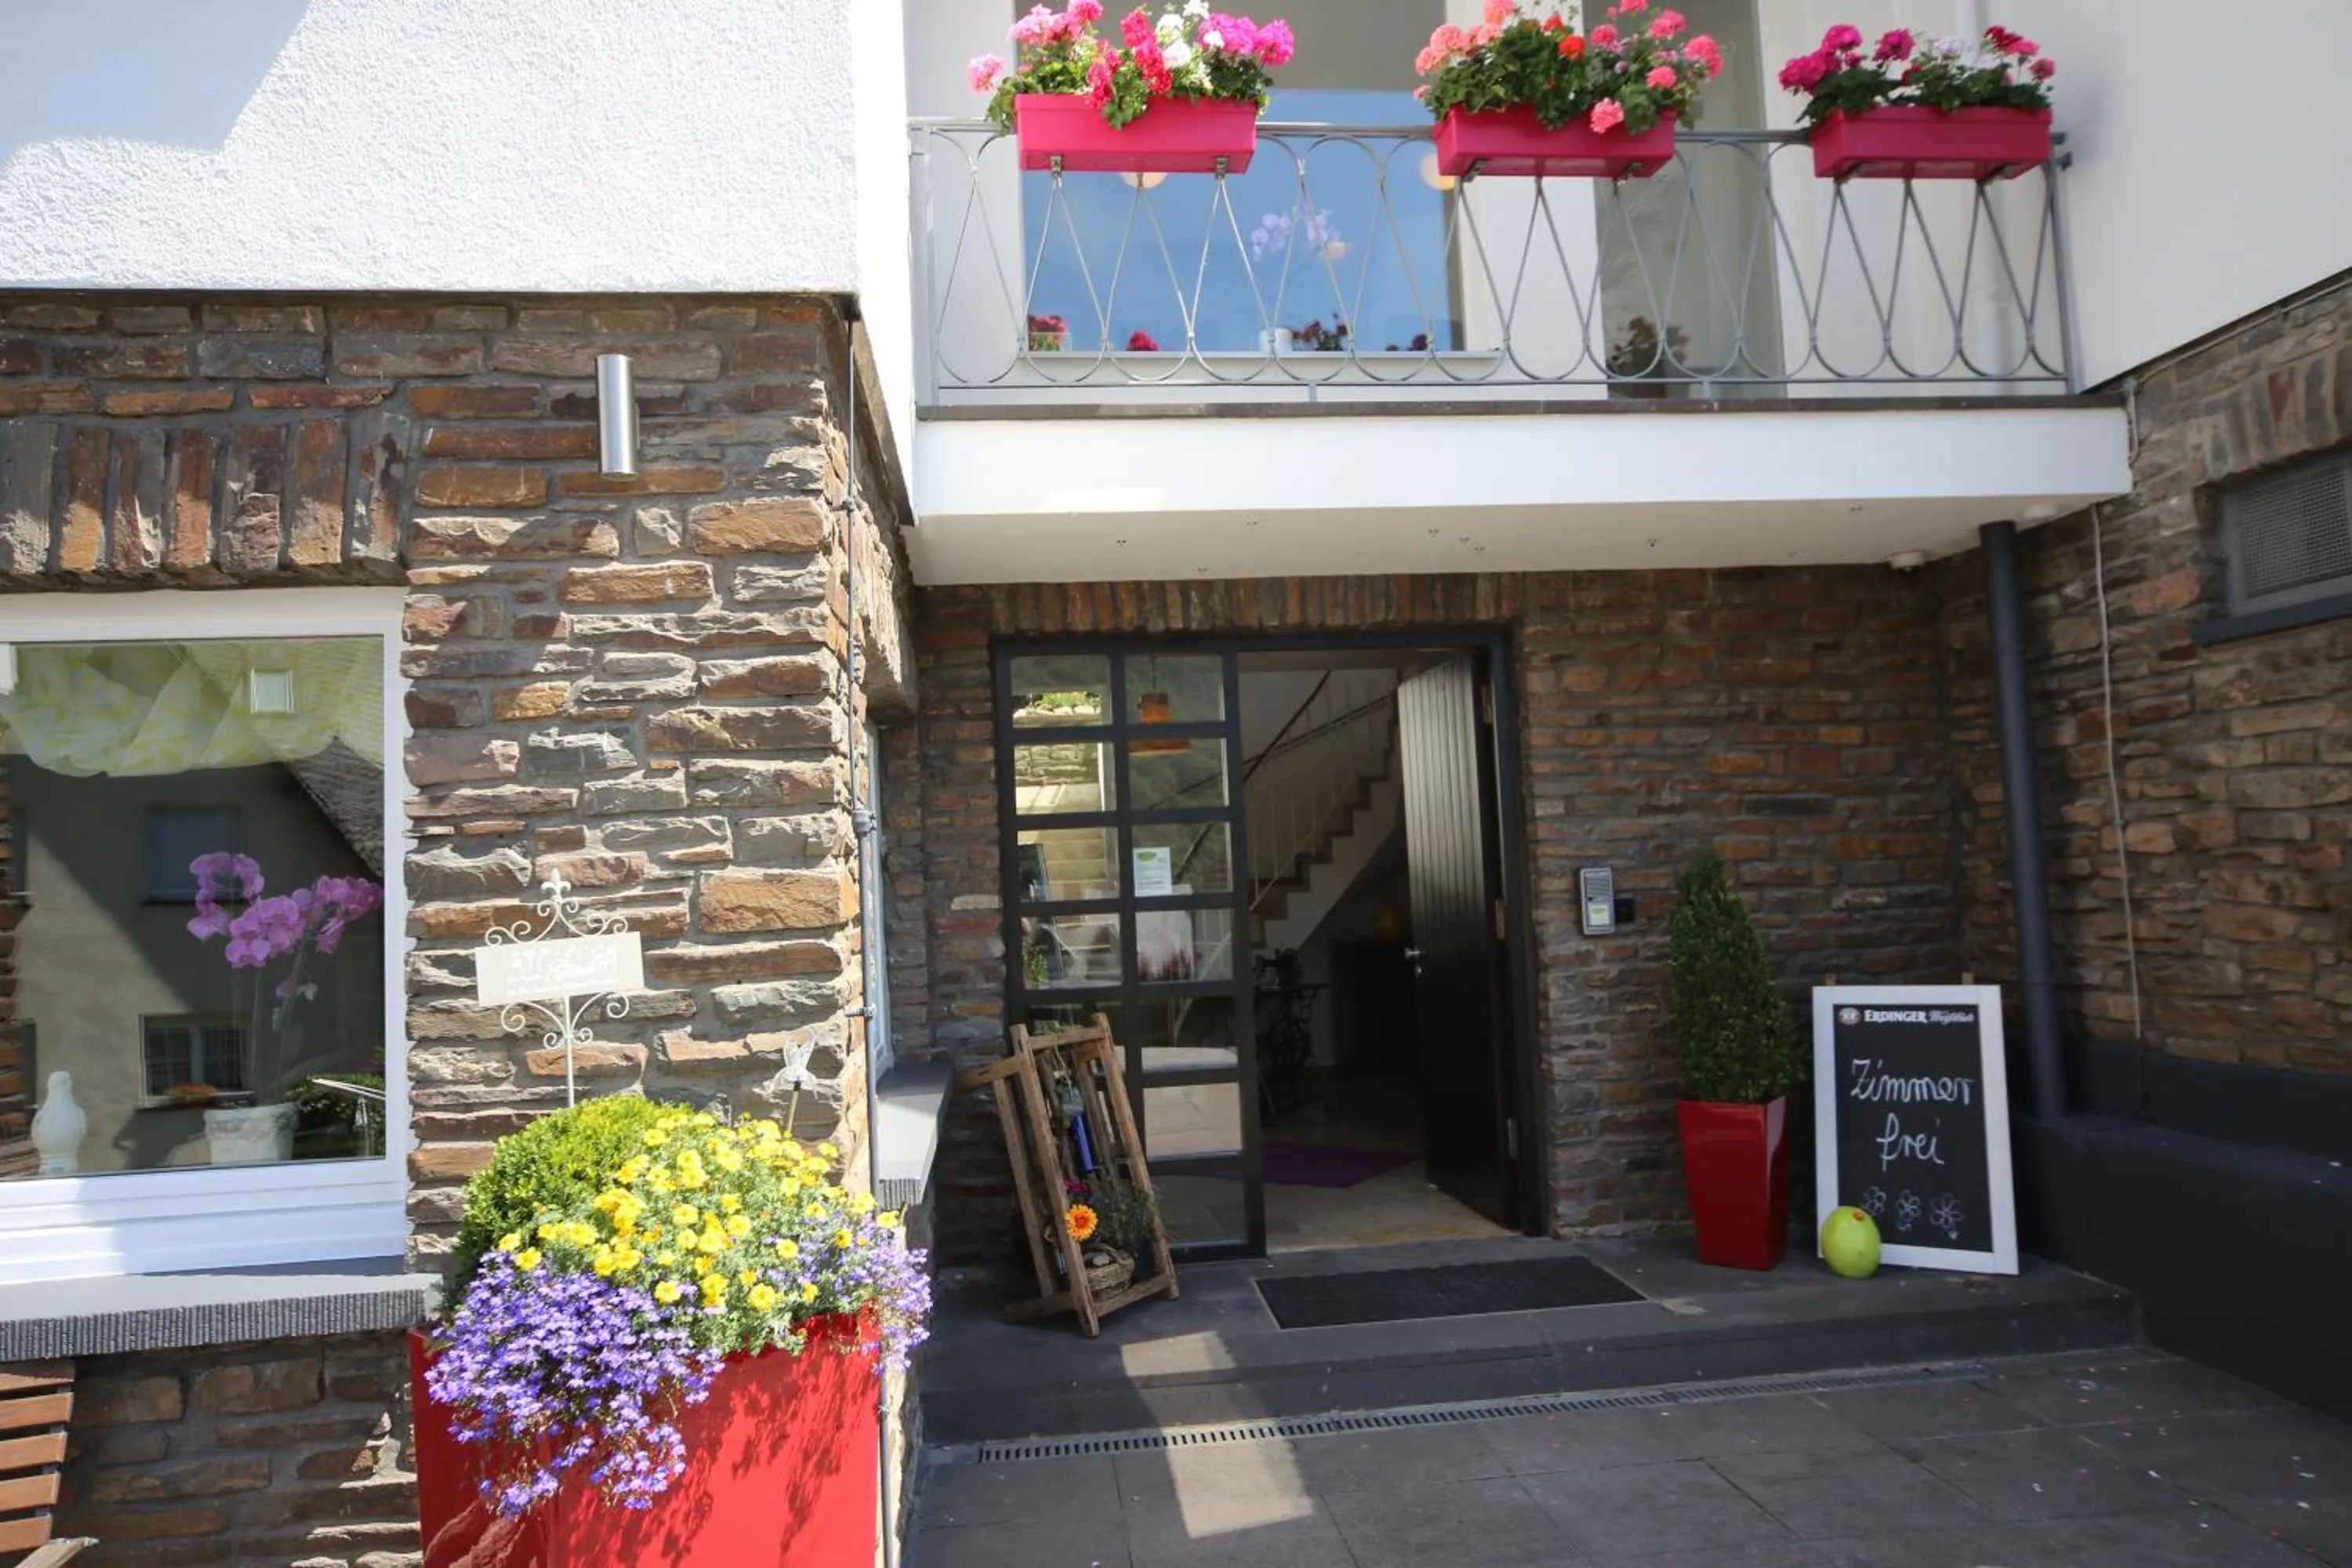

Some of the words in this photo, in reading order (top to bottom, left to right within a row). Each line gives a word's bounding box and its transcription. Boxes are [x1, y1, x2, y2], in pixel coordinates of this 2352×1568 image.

[1864, 1009, 1928, 1023] ERDINGER
[1851, 1058, 1973, 1105] Zimmer
[1876, 1112, 1945, 1171] frei
